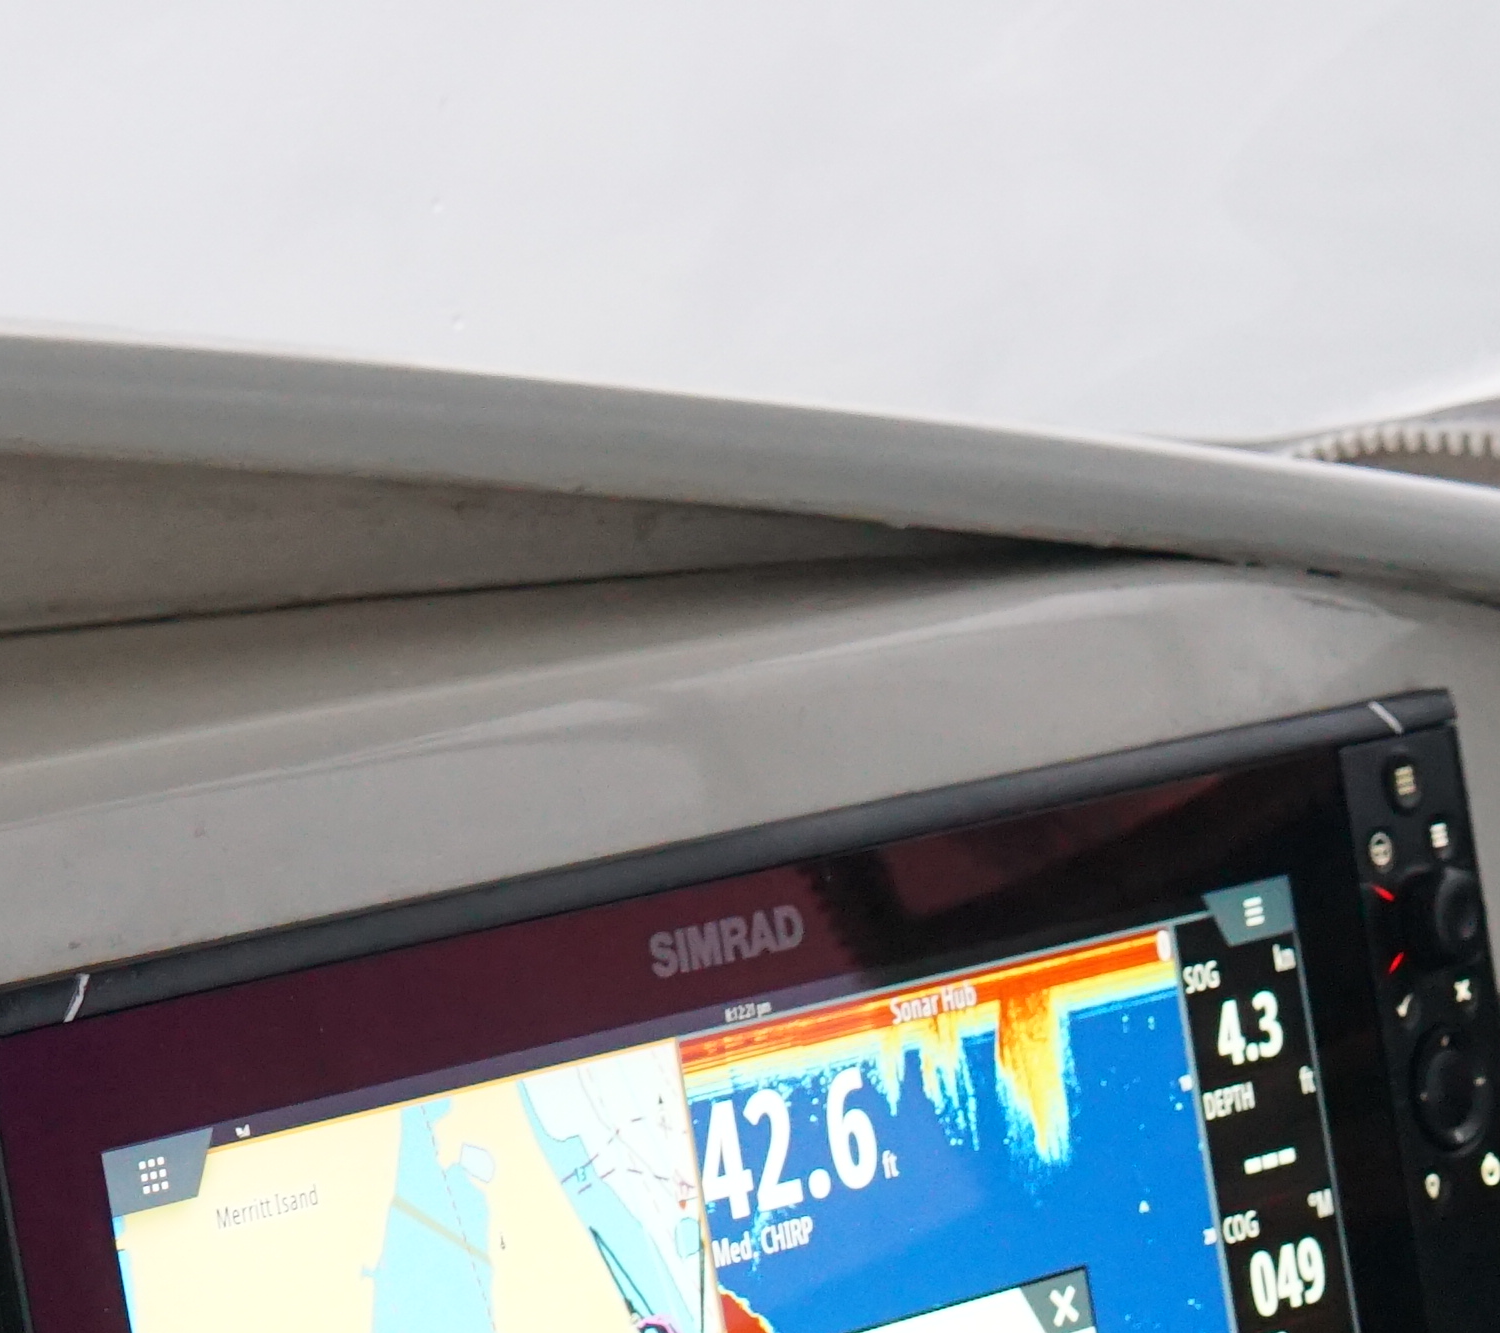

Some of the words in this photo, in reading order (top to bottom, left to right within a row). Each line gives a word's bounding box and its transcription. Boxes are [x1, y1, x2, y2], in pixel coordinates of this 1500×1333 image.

[649, 905, 803, 978] SIMRAD
[1182, 960, 1220, 994] SOG
[890, 995, 938, 1025] Sonar
[942, 982, 977, 1012] Hub
[1217, 990, 1283, 1065] 4.3
[1203, 1081, 1255, 1121] DEPTH
[701, 1067, 877, 1219] 42.6
[882, 1149, 900, 1178] ft
[216, 1198, 272, 1229] Merritt
[1223, 1210, 1260, 1245] COG
[760, 1216, 813, 1256] CHIRP
[1249, 1236, 1325, 1317] 049
